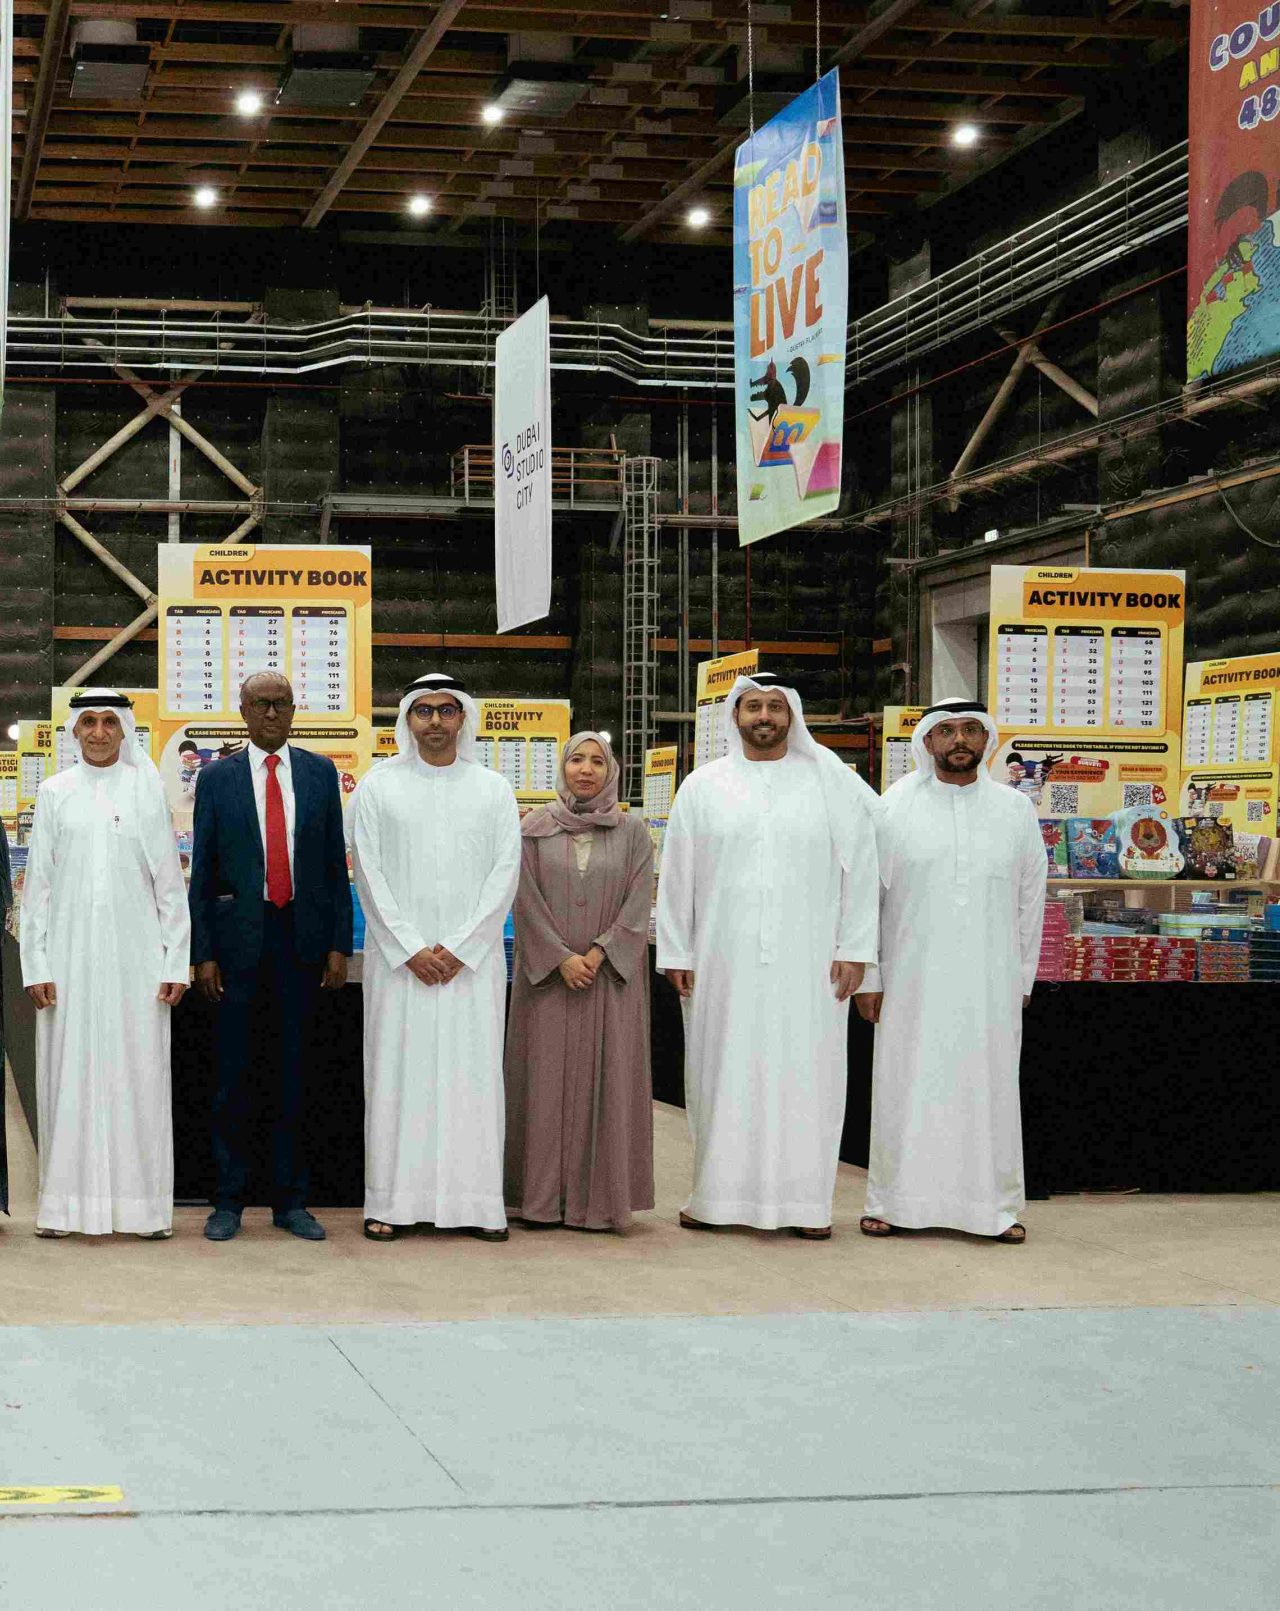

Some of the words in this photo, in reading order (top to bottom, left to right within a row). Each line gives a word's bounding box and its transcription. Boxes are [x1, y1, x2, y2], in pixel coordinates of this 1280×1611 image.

[748, 142, 822, 238] READ
[750, 227, 782, 287] TO
[750, 248, 824, 358] LIVE
[517, 421, 540, 454] DUBAI
[517, 448, 544, 482] STUDIO
[517, 482, 533, 510] CITY
[200, 570, 303, 586] ACTIVITY
[308, 571, 368, 586] BOOK
[1029, 591, 1123, 607] ACTIVITY
[1126, 593, 1181, 608] BOOK
[708, 668, 737, 684] ACTIVITY
[1203, 671, 1252, 685] ACTIVITY
[486, 711, 543, 720] ACTIVITY
[486, 722, 519, 730] BOOK
